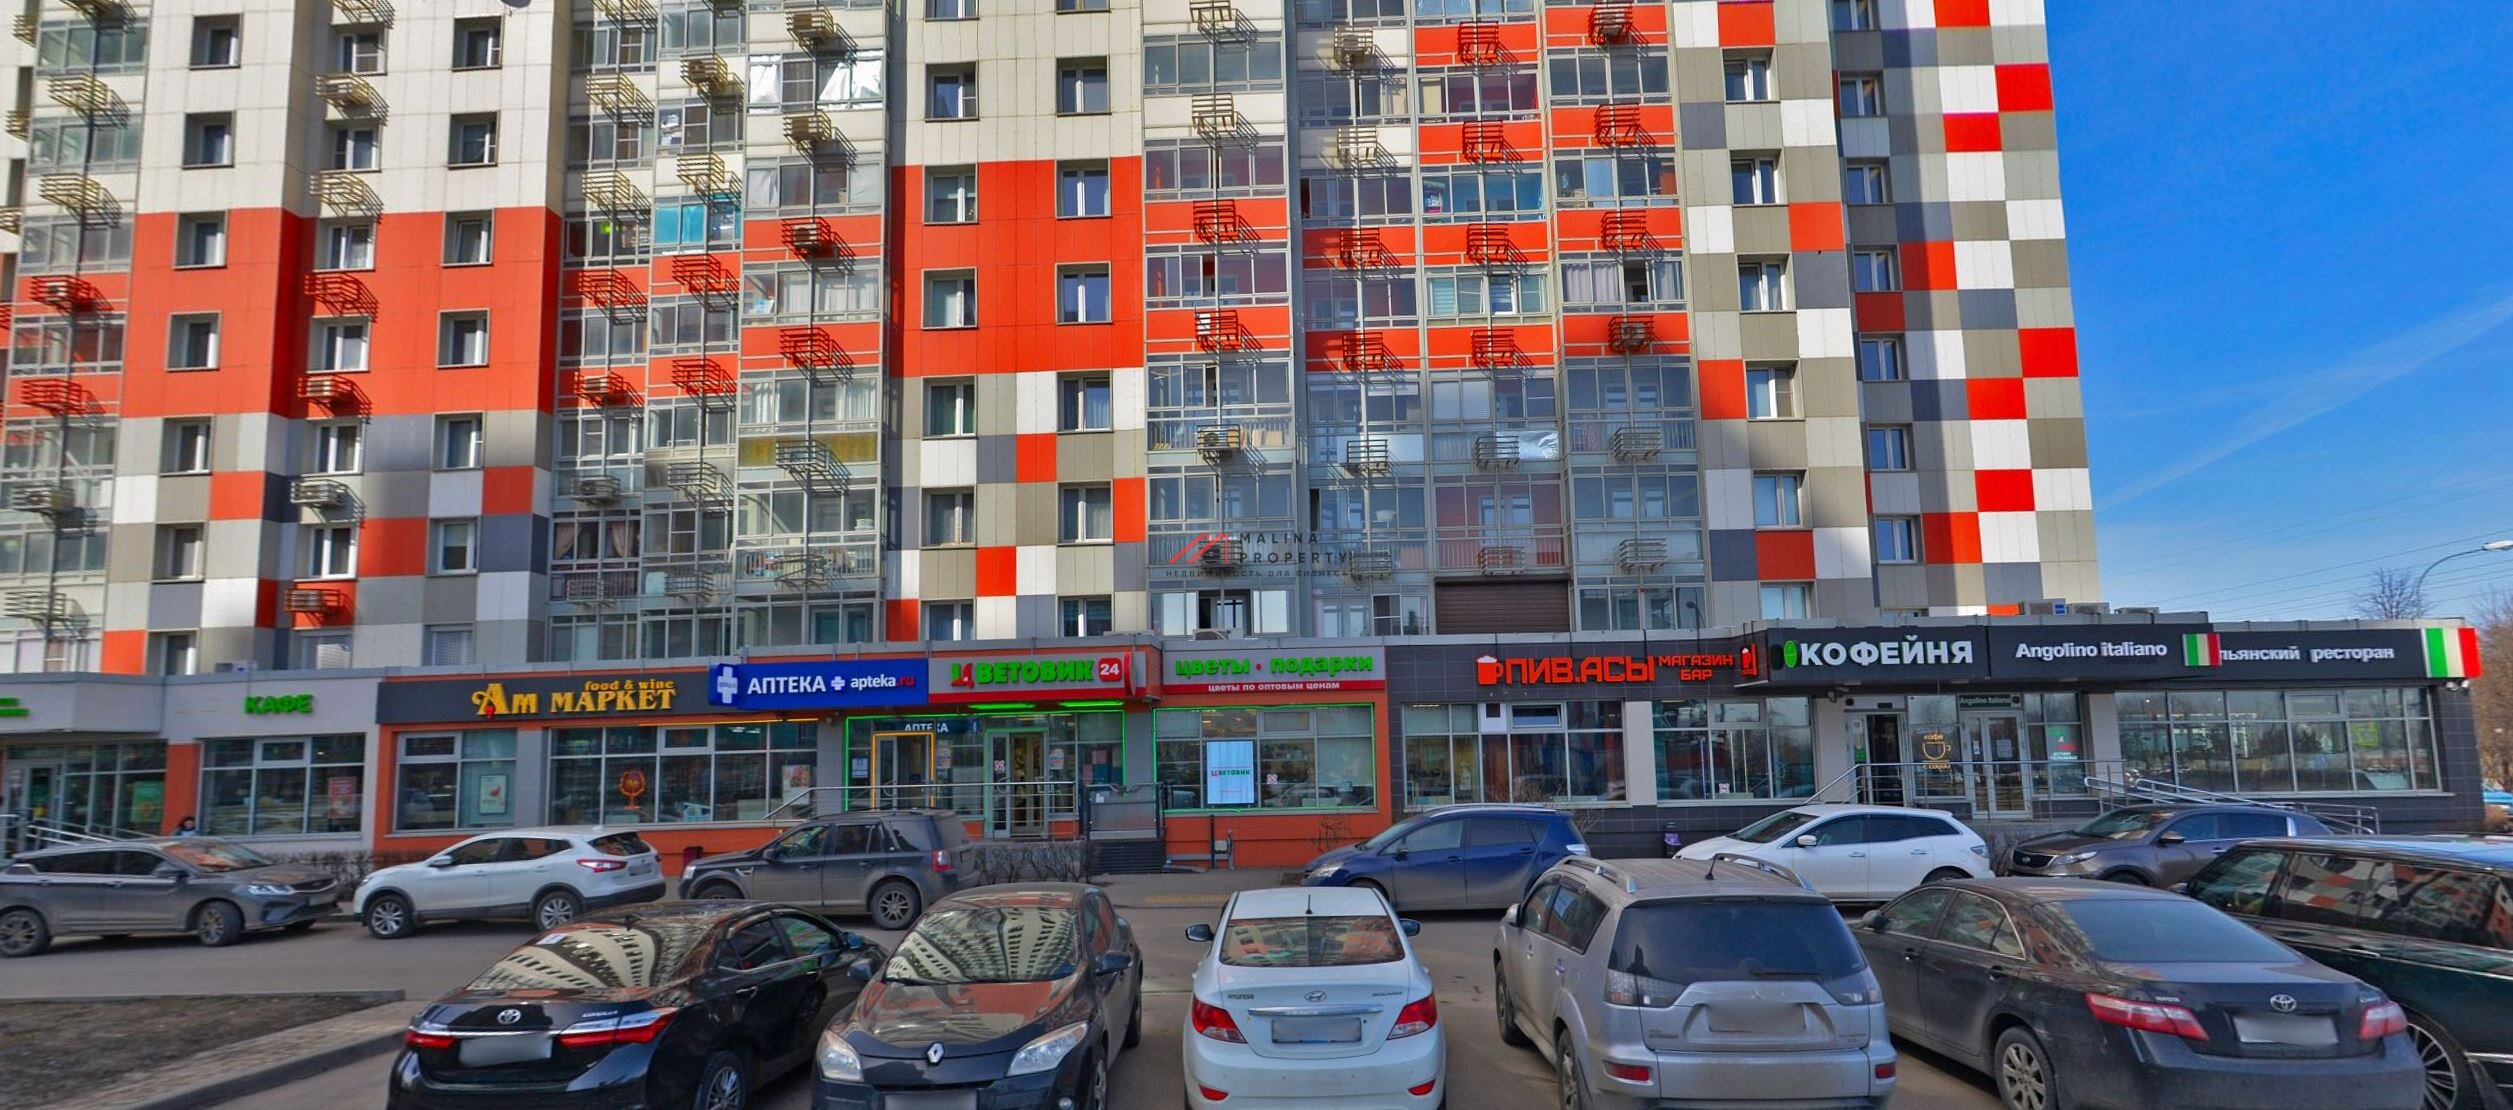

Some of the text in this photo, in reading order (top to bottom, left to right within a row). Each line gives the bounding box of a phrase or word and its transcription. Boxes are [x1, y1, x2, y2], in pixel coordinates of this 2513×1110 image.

[1801, 634, 1973, 666] КОФЕЙНЯ
[2015, 641, 2168, 661] Angolino italiano
[2310, 646, 2395, 663] ресторан
[1175, 656, 1373, 679] цветы подарки
[1505, 655, 1655, 684] ПИВ.АСЫ
[1658, 655, 1733, 667] МАГАЗИН
[850, 673, 915, 691] apteka.ru
[951, 660, 1120, 688] ЦВЕТОВИК 24
[1680, 669, 1713, 681] БАР
[584, 679, 674, 691] food & wine
[747, 676, 827, 694] АПТЕКА
[1258, 682, 1303, 691] оптовым
[1306, 682, 1340, 691] ценам
[245, 694, 314, 715] КАФЕ
[550, 689, 676, 713] МАРКЕТ
